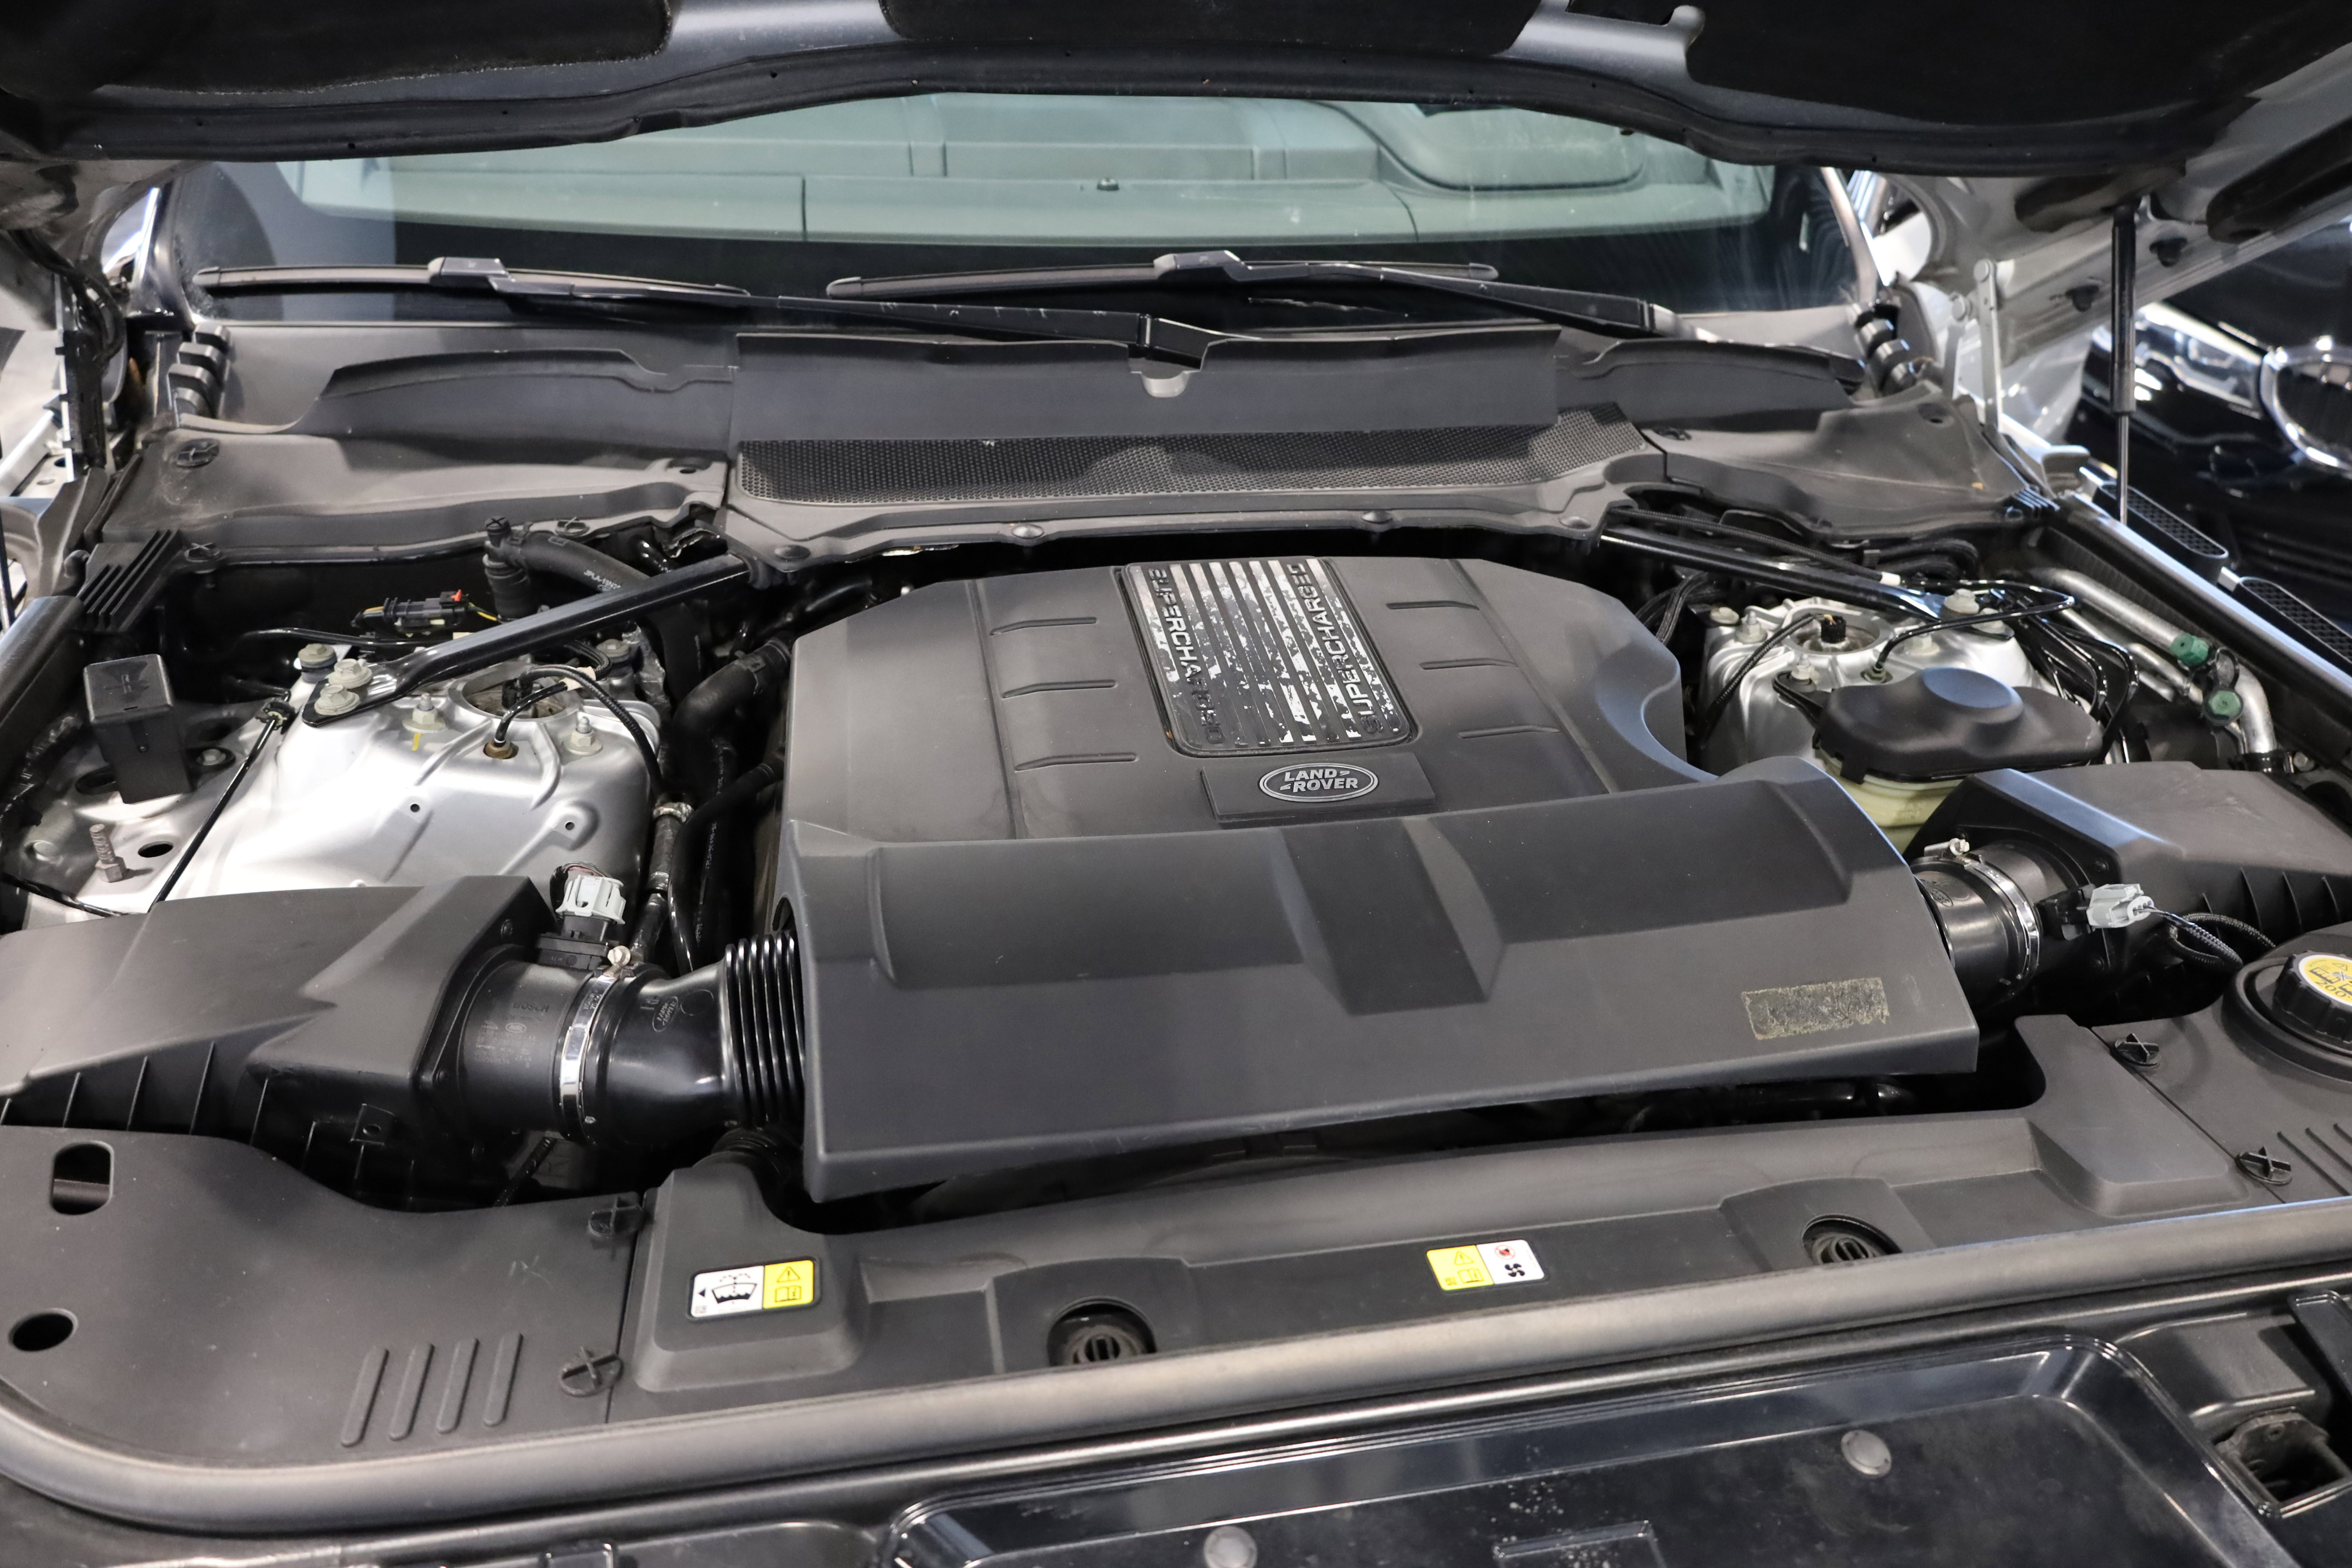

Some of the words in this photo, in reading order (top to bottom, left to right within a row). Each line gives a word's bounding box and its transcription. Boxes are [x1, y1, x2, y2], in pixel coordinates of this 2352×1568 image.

[1148, 568, 1225, 744] SUPERCHARGED
[1286, 562, 1384, 734] SUPERCHARGED
[1284, 768, 1337, 782] LAND
[1292, 777, 1358, 793] ROVER
[2314, 979, 2347, 997] 200
[513, 1001, 550, 1013] BOSCH
